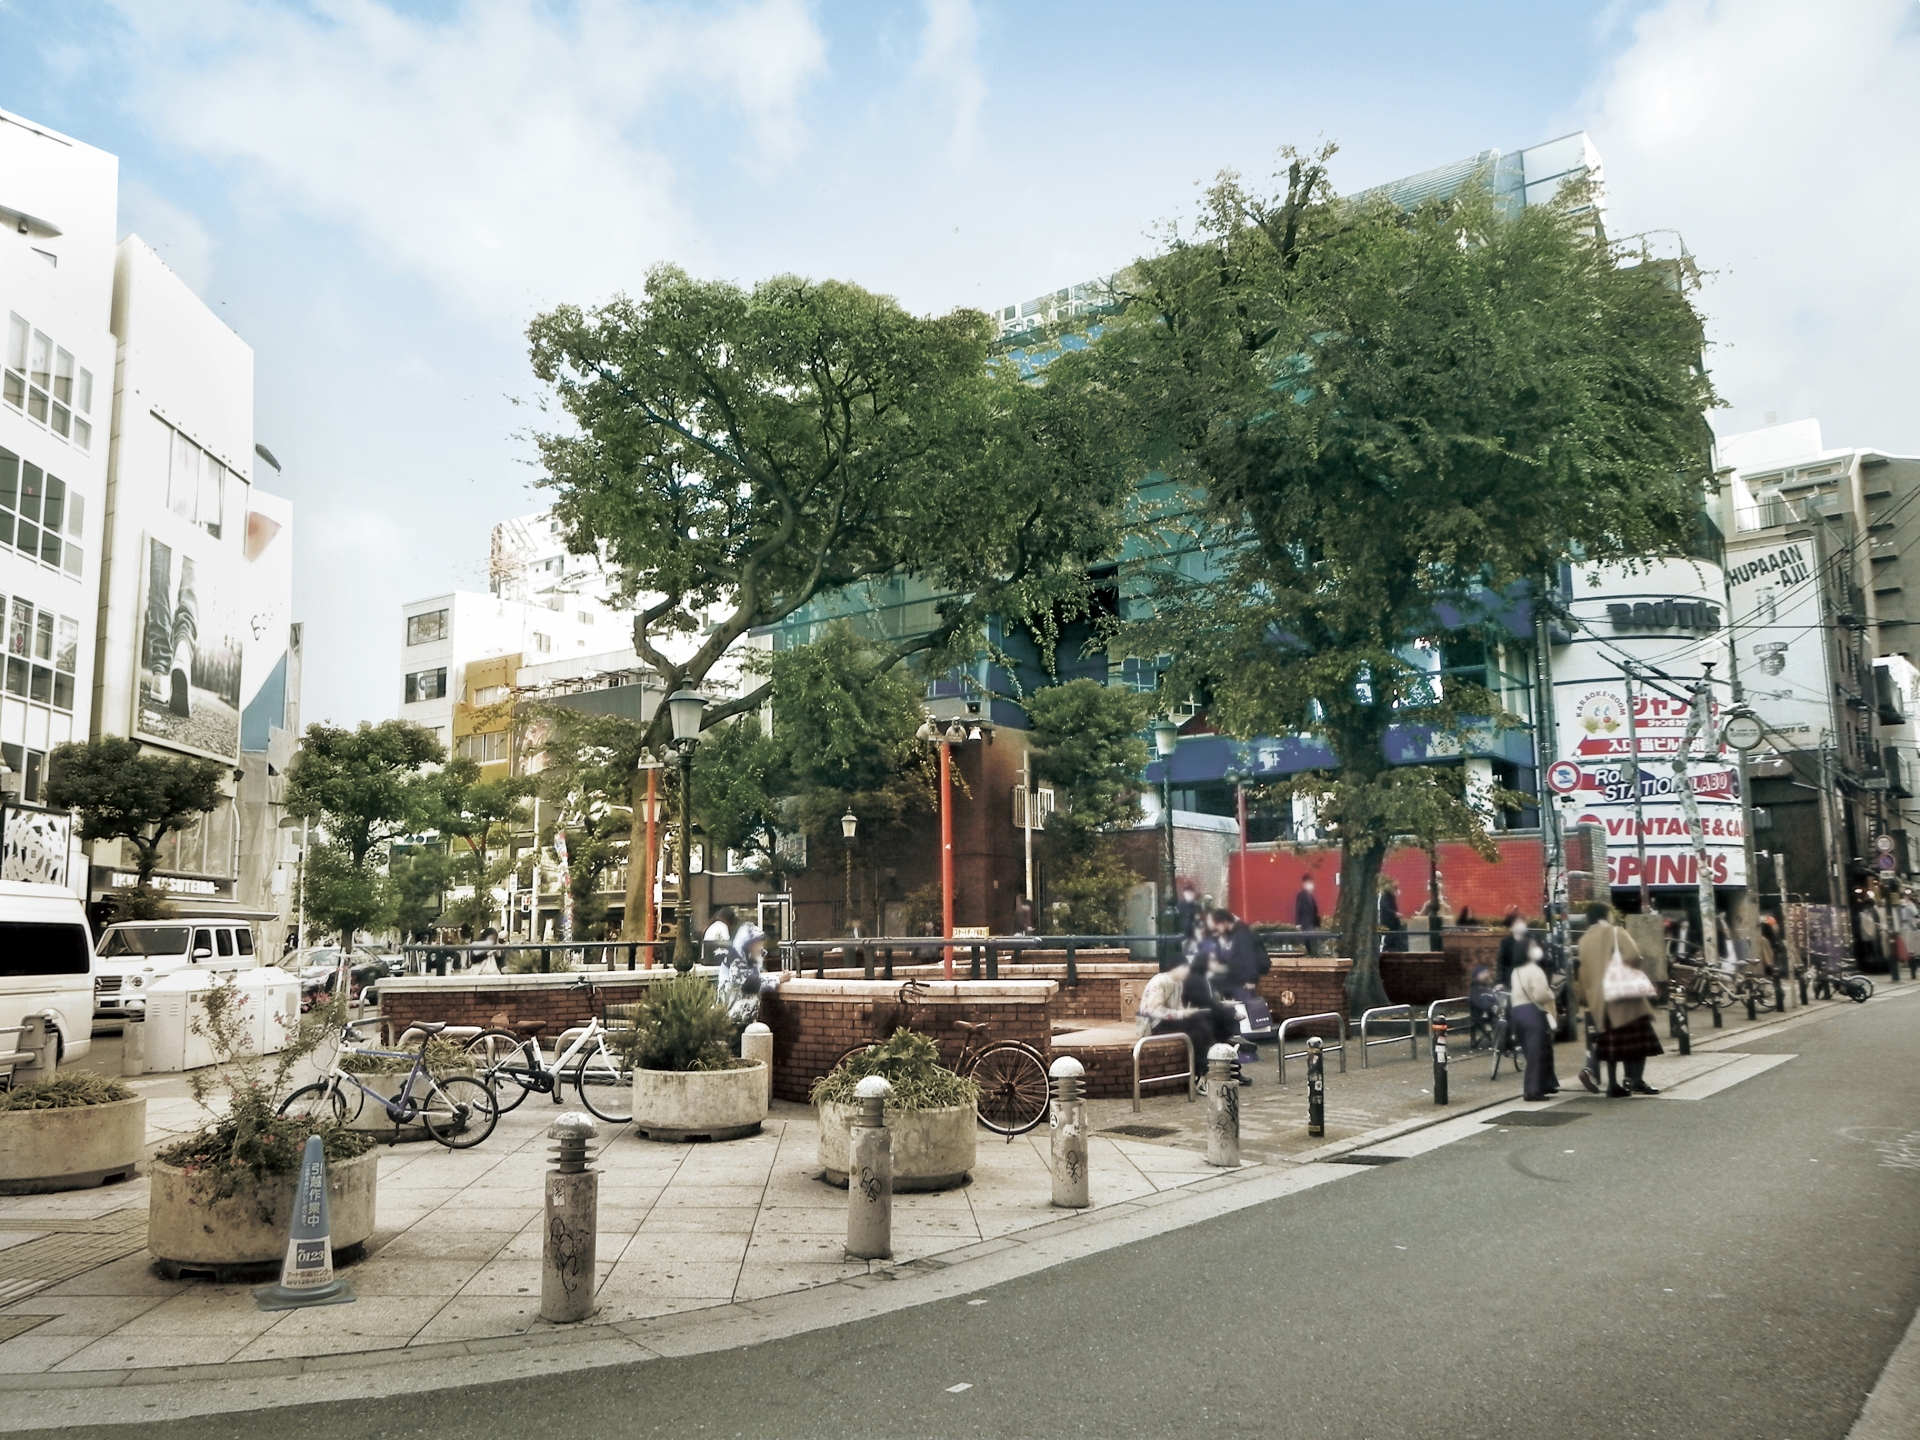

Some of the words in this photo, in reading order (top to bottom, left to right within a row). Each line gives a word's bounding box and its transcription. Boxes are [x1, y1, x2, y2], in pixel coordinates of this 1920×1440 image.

[1724, 544, 1803, 588] HUPAAAN
[307, 1162, 323, 1228] 引越作業中
